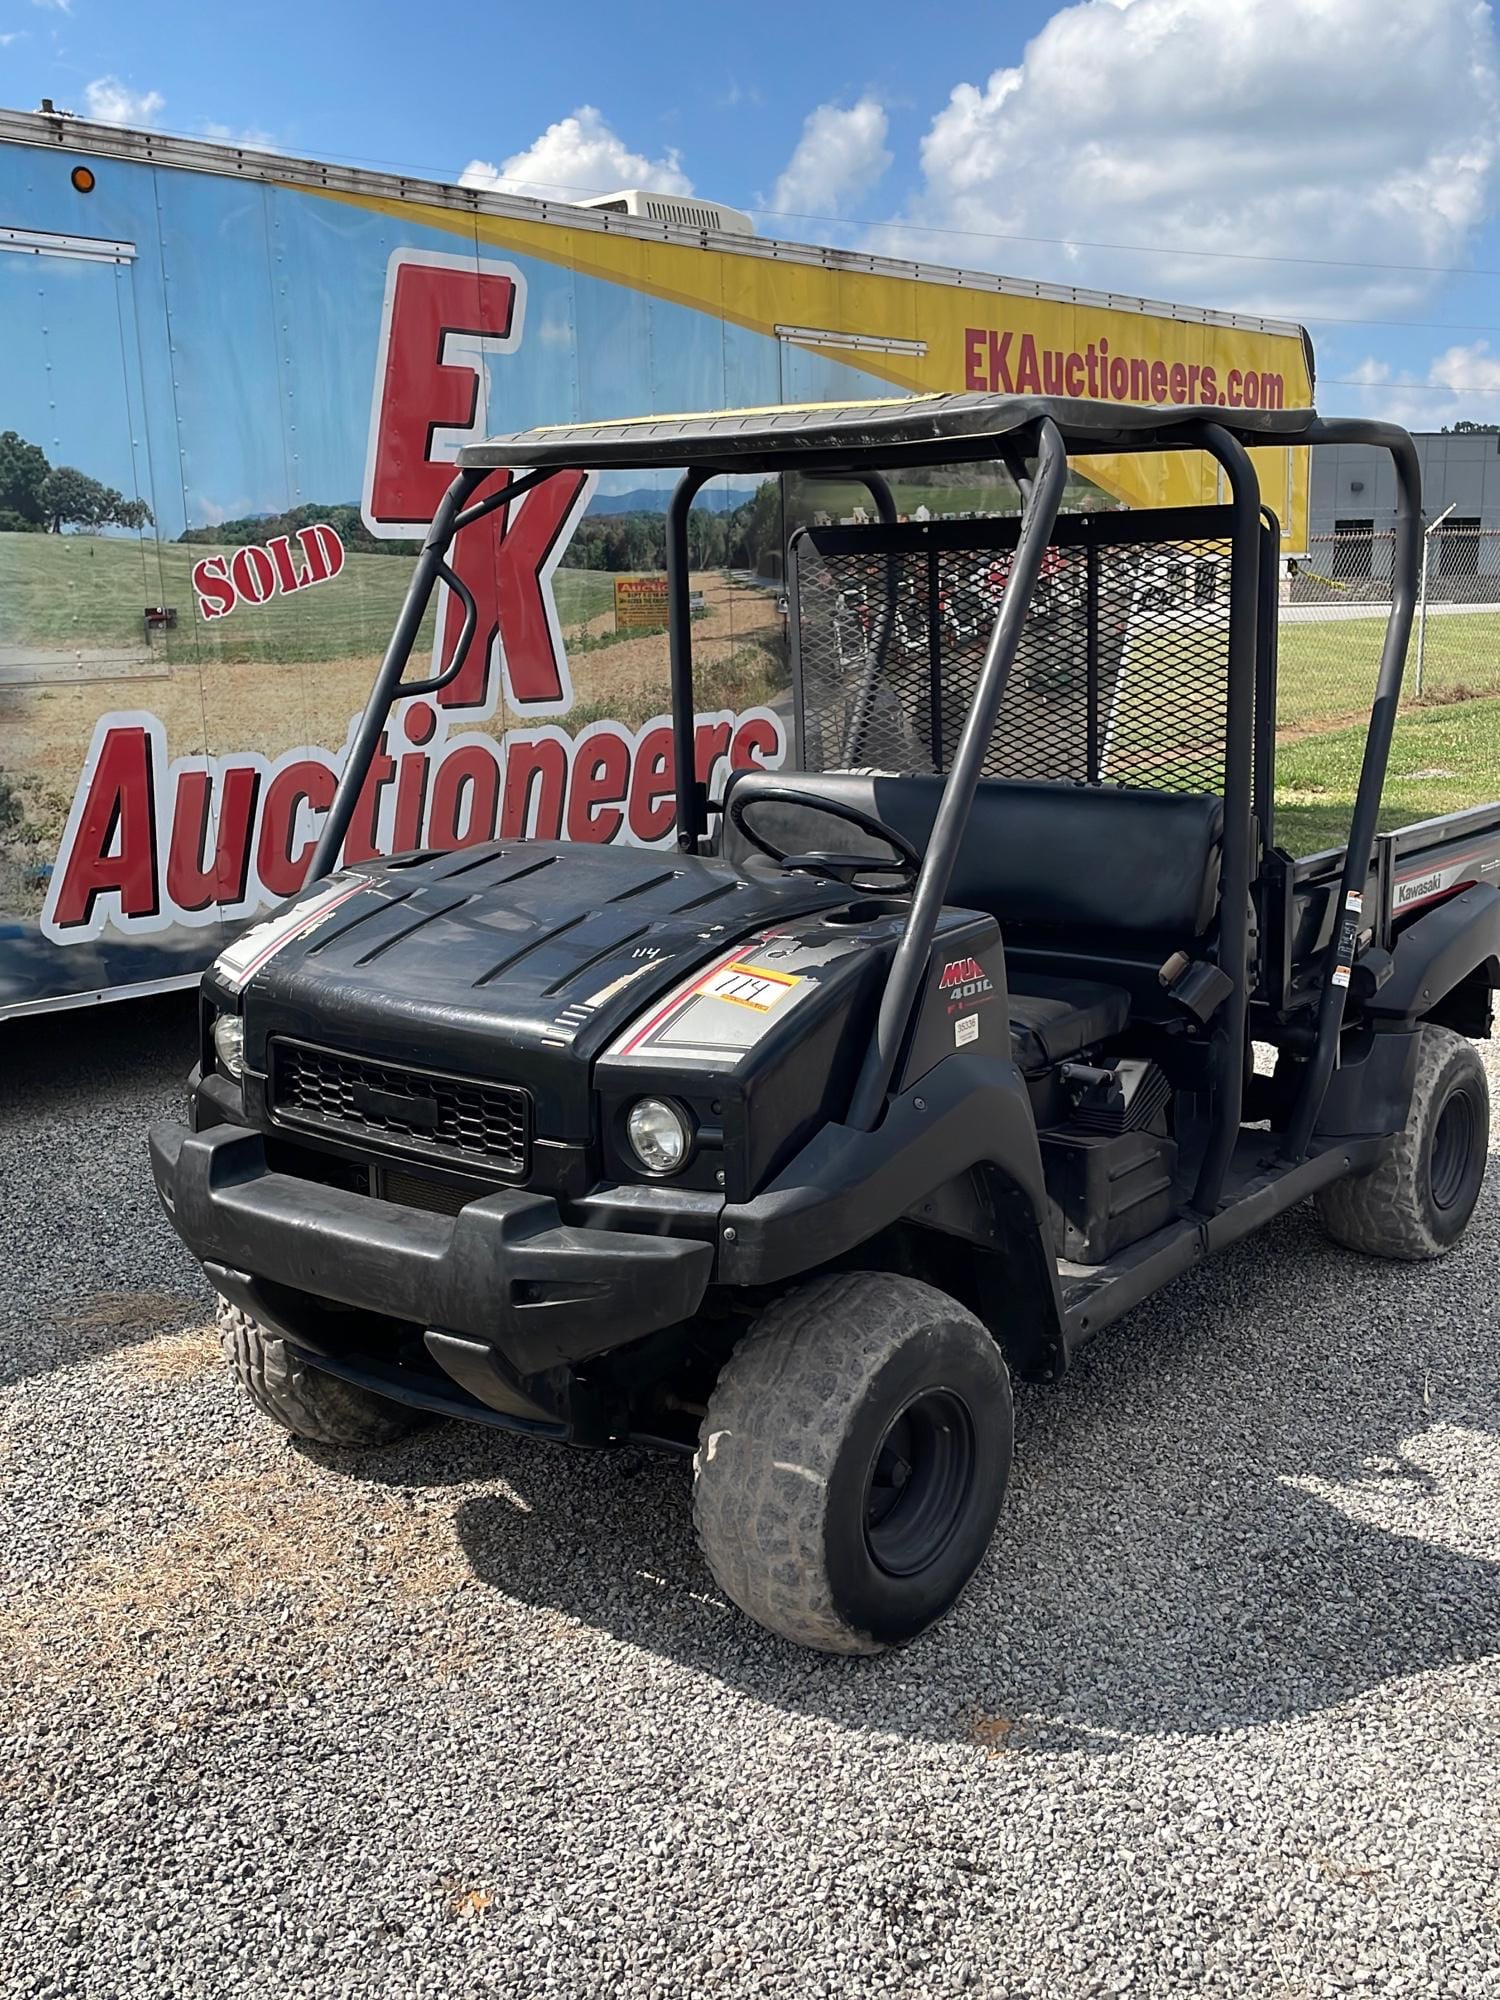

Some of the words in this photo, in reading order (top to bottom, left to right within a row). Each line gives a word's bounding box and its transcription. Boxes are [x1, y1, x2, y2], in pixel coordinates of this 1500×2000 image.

[964, 327, 1284, 410] EKAuctioneers.com
[370, 263, 589, 710] EK
[192, 524, 345, 621] SOLD
[51, 700, 780, 928] Auctioneers
[1398, 872, 1442, 903] Kawasaki
[631, 947, 661, 959] 114
[715, 975, 770, 1001] 114
